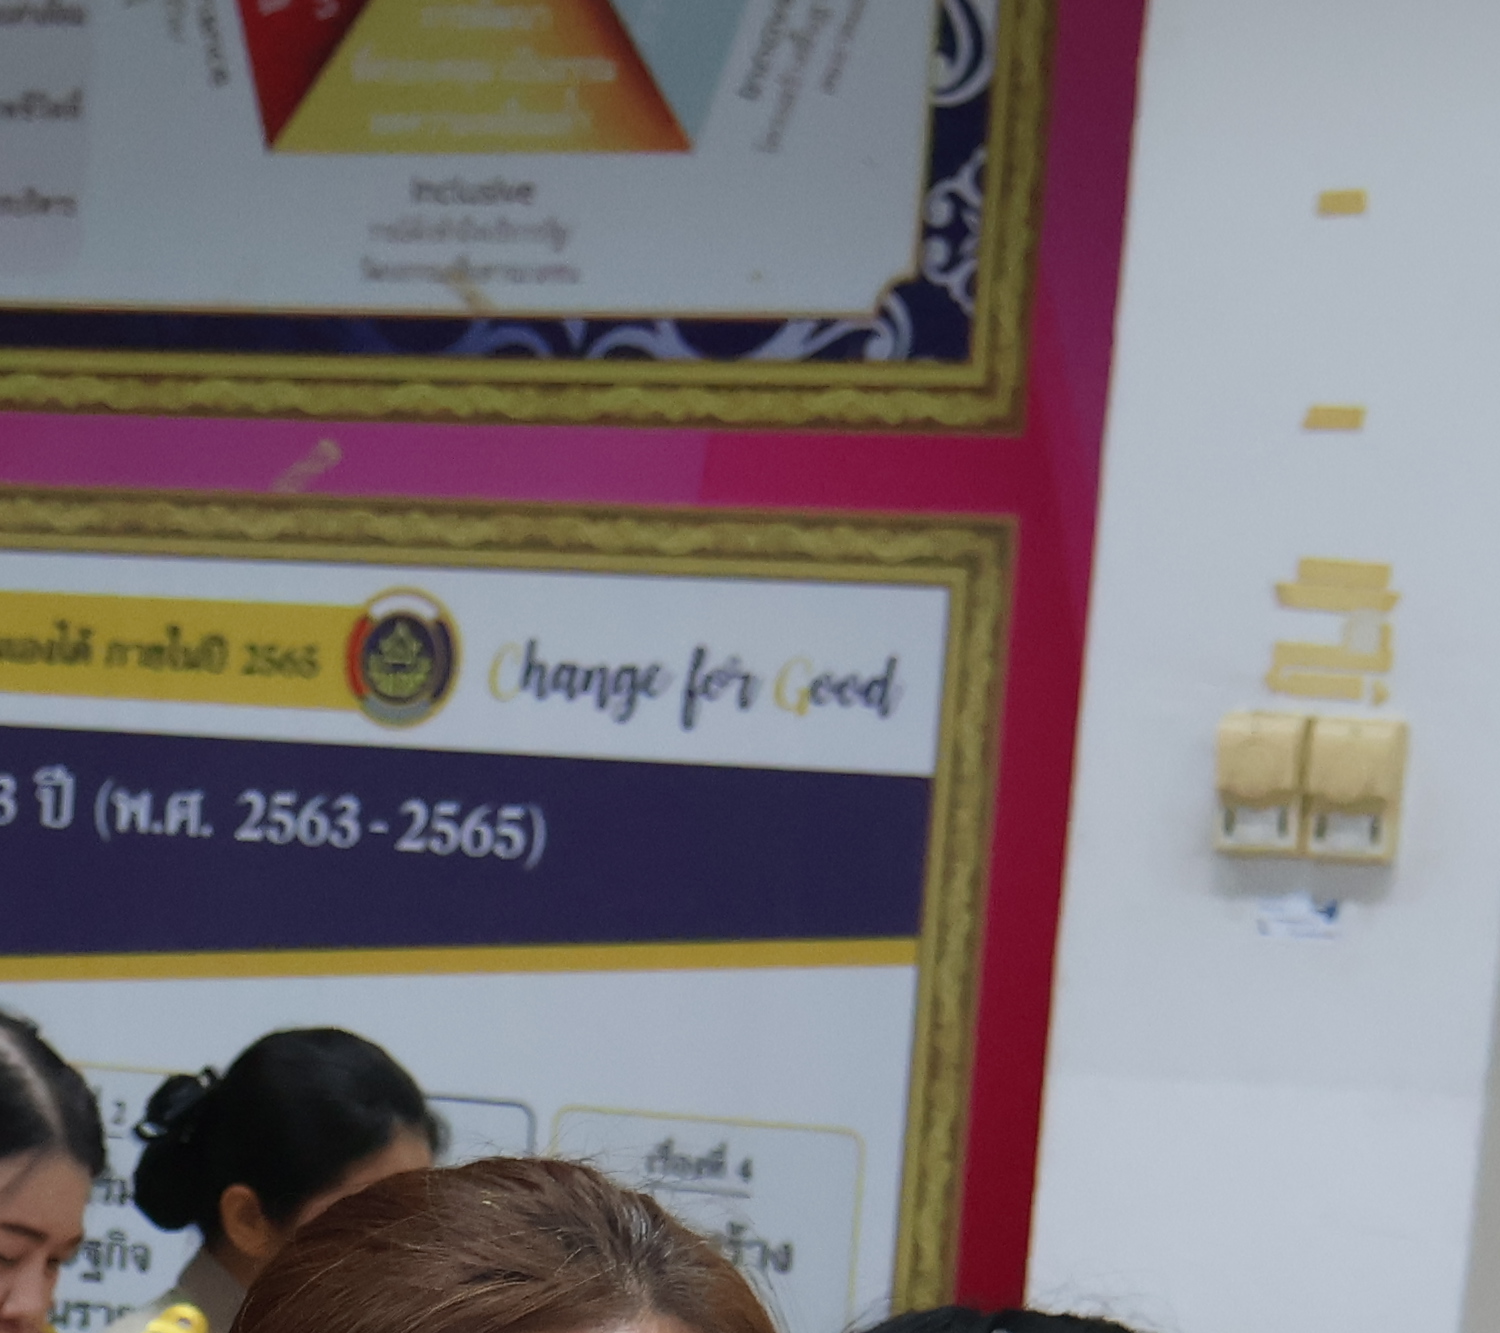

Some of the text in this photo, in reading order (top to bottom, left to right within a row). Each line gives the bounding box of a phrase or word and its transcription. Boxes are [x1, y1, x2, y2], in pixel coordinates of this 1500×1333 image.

[241, 641, 320, 680] 2565
[488, 638, 900, 731] Change for Good
[32, 763, 75, 831] ปี
[94, 776, 214, 842] (พ.ศ.
[738, 1154, 754, 1183] 4
